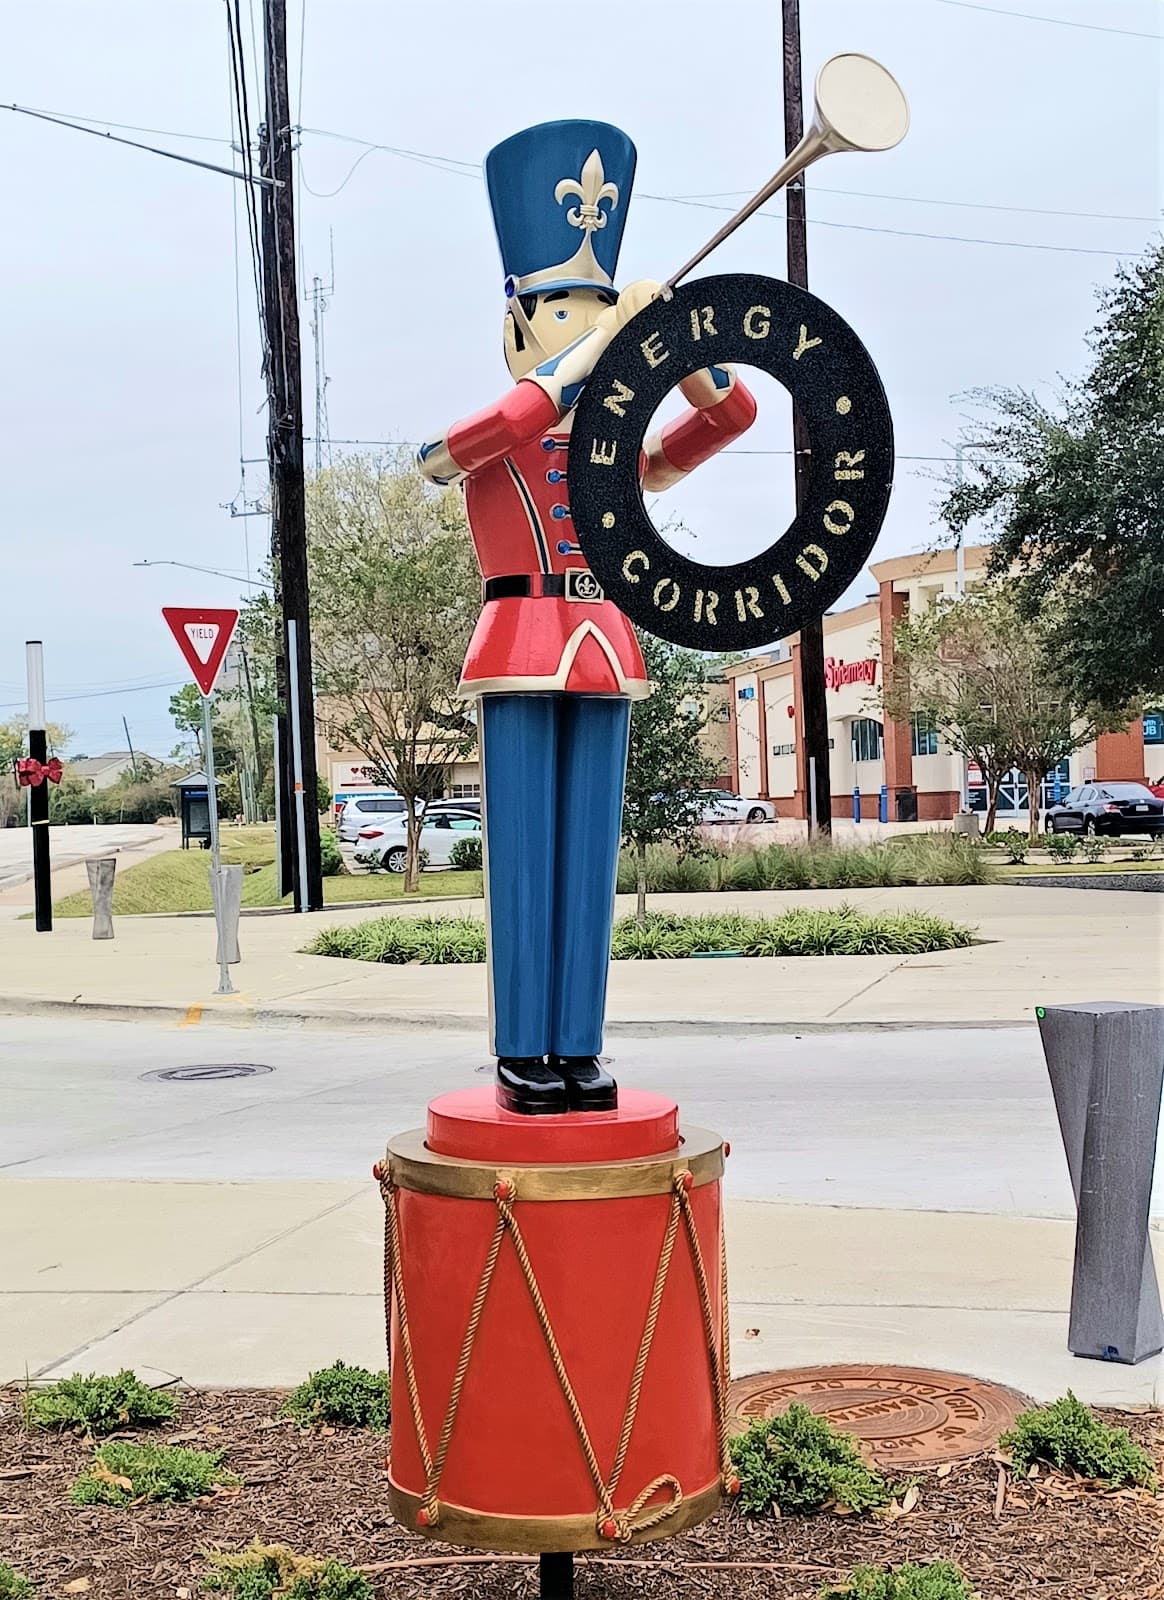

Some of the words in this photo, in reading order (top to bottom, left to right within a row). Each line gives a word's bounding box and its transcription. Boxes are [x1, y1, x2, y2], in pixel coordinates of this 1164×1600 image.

[590, 304, 822, 466] ENERGY
[621, 449, 865, 625] CORRIDOR
[190, 628, 214, 639] YIELD
[834, 659, 877, 692] pharmacy
[1142, 726, 1157, 735] UB
[811, 1380, 844, 1391] OF
[867, 1381, 937, 1395] CITY
[742, 1388, 799, 1417] HOUST
[826, 1398, 919, 1422] SANITA
[944, 1398, 979, 1421] CITY
[936, 1426, 966, 1441] OF
